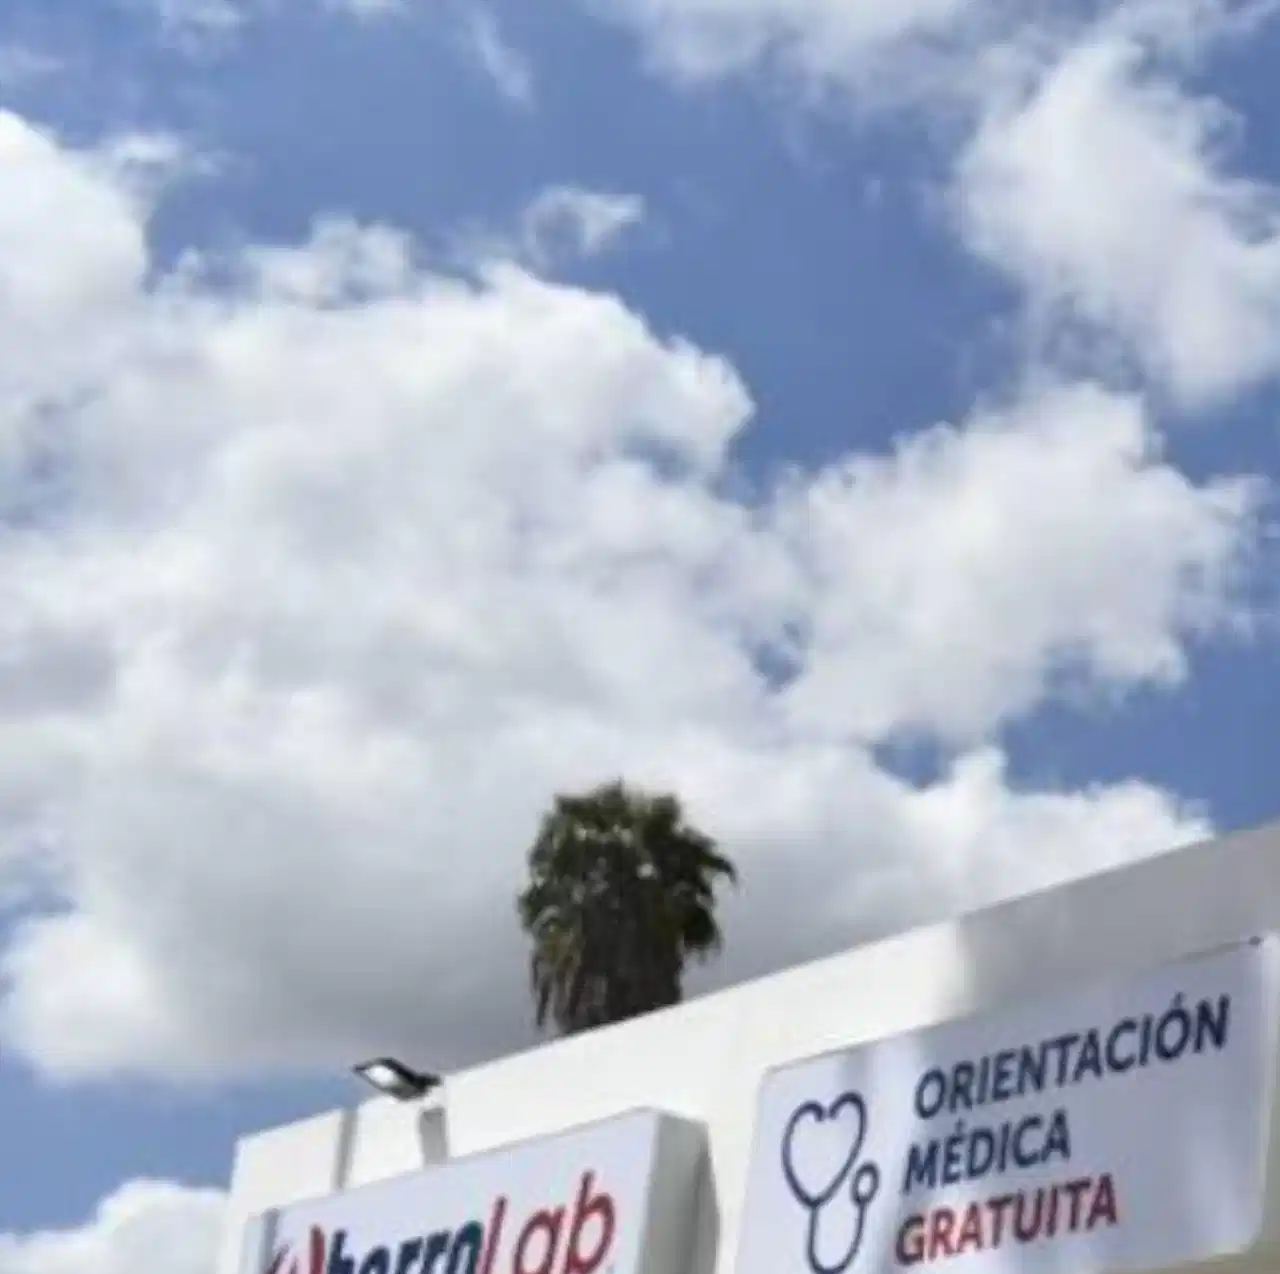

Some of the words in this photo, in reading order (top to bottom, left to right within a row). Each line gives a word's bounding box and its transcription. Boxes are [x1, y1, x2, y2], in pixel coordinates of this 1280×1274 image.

[913, 991, 1233, 1121] ORIENTACIÓN
[900, 1105, 1073, 1197] MÉDICA
[894, 1171, 1119, 1268] GRATUITA
